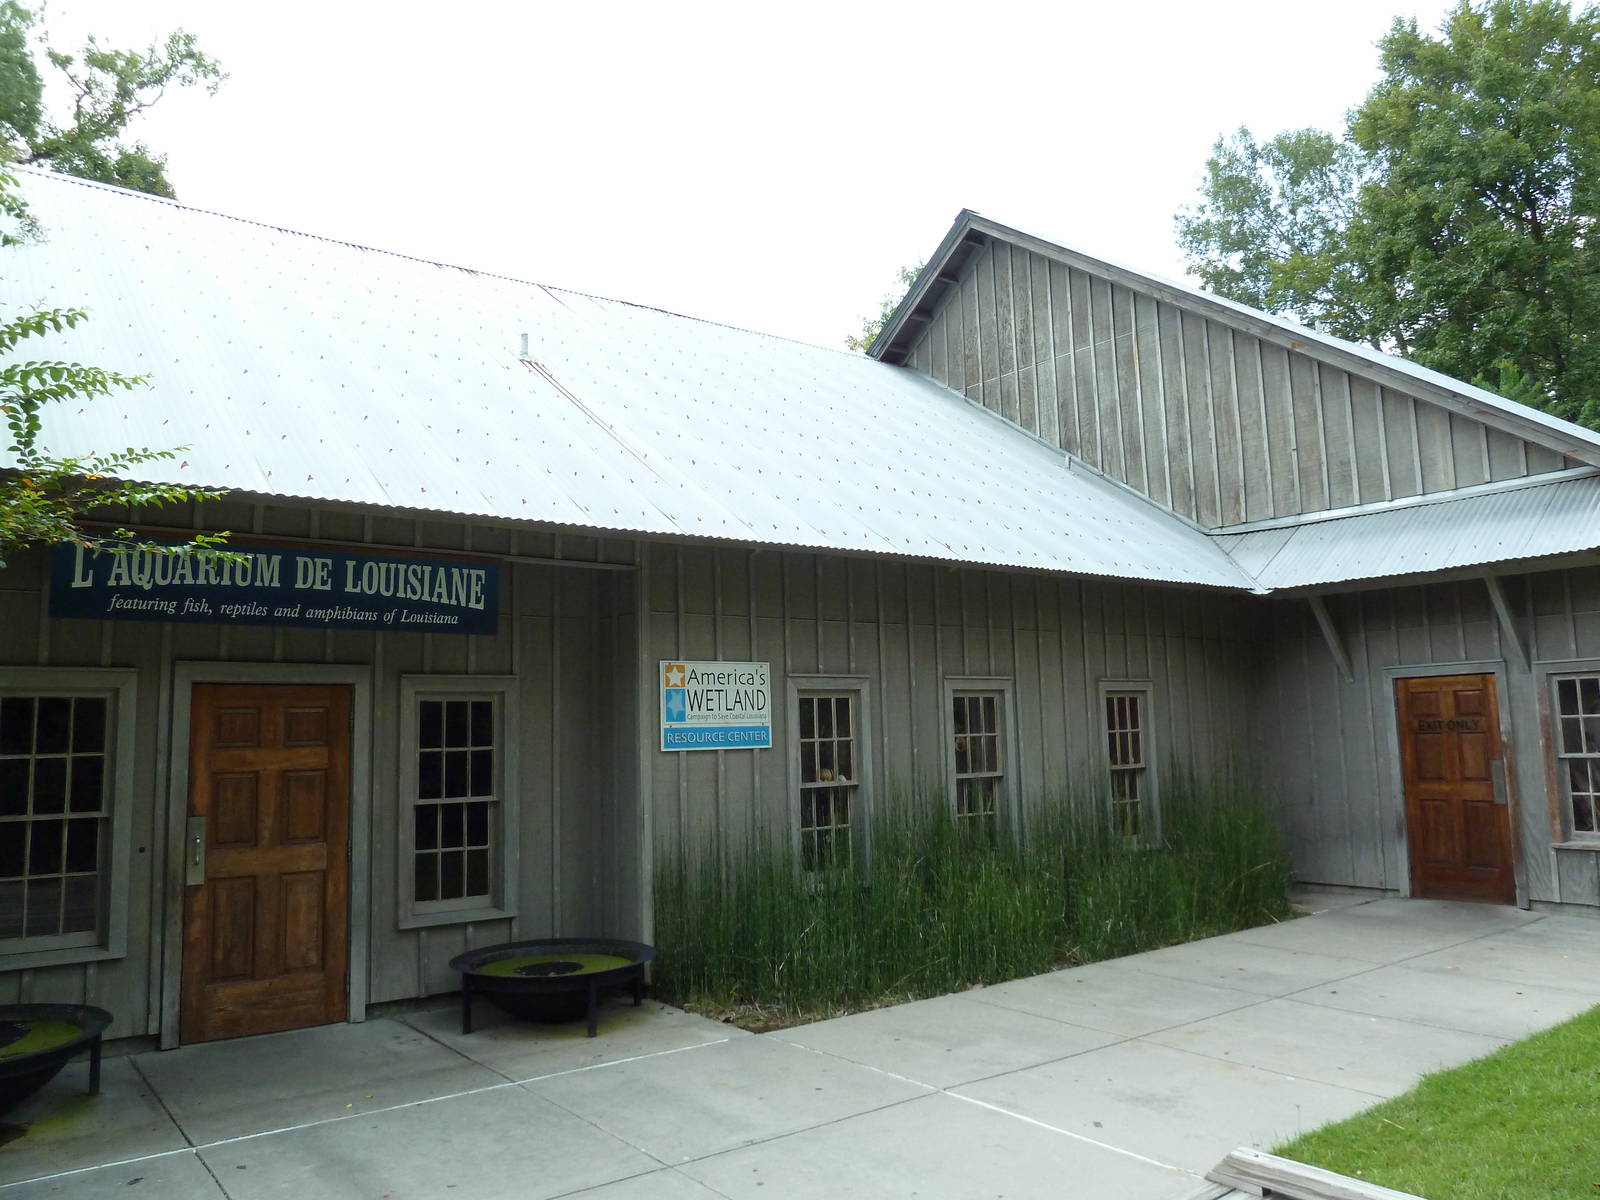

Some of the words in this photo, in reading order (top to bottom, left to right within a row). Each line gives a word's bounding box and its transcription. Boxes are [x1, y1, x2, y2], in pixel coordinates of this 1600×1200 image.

[295, 556, 332, 591] DE
[344, 560, 486, 610] LOUISIANE
[107, 594, 177, 614] featuring
[181, 598, 213, 616] fish,
[220, 601, 268, 618] reptiles
[274, 604, 300, 618] and
[305, 605, 378, 622] amphibians
[383, 608, 399, 625] of
[400, 609, 459, 625] Louisiana
[687, 668, 766, 685] America's
[687, 689, 766, 712] WETLAND
[1418, 719, 1443, 731] EXIT
[1447, 719, 1480, 731] ONLY
[667, 732, 725, 744] RESOURCE
[727, 730, 768, 742] CENTER
